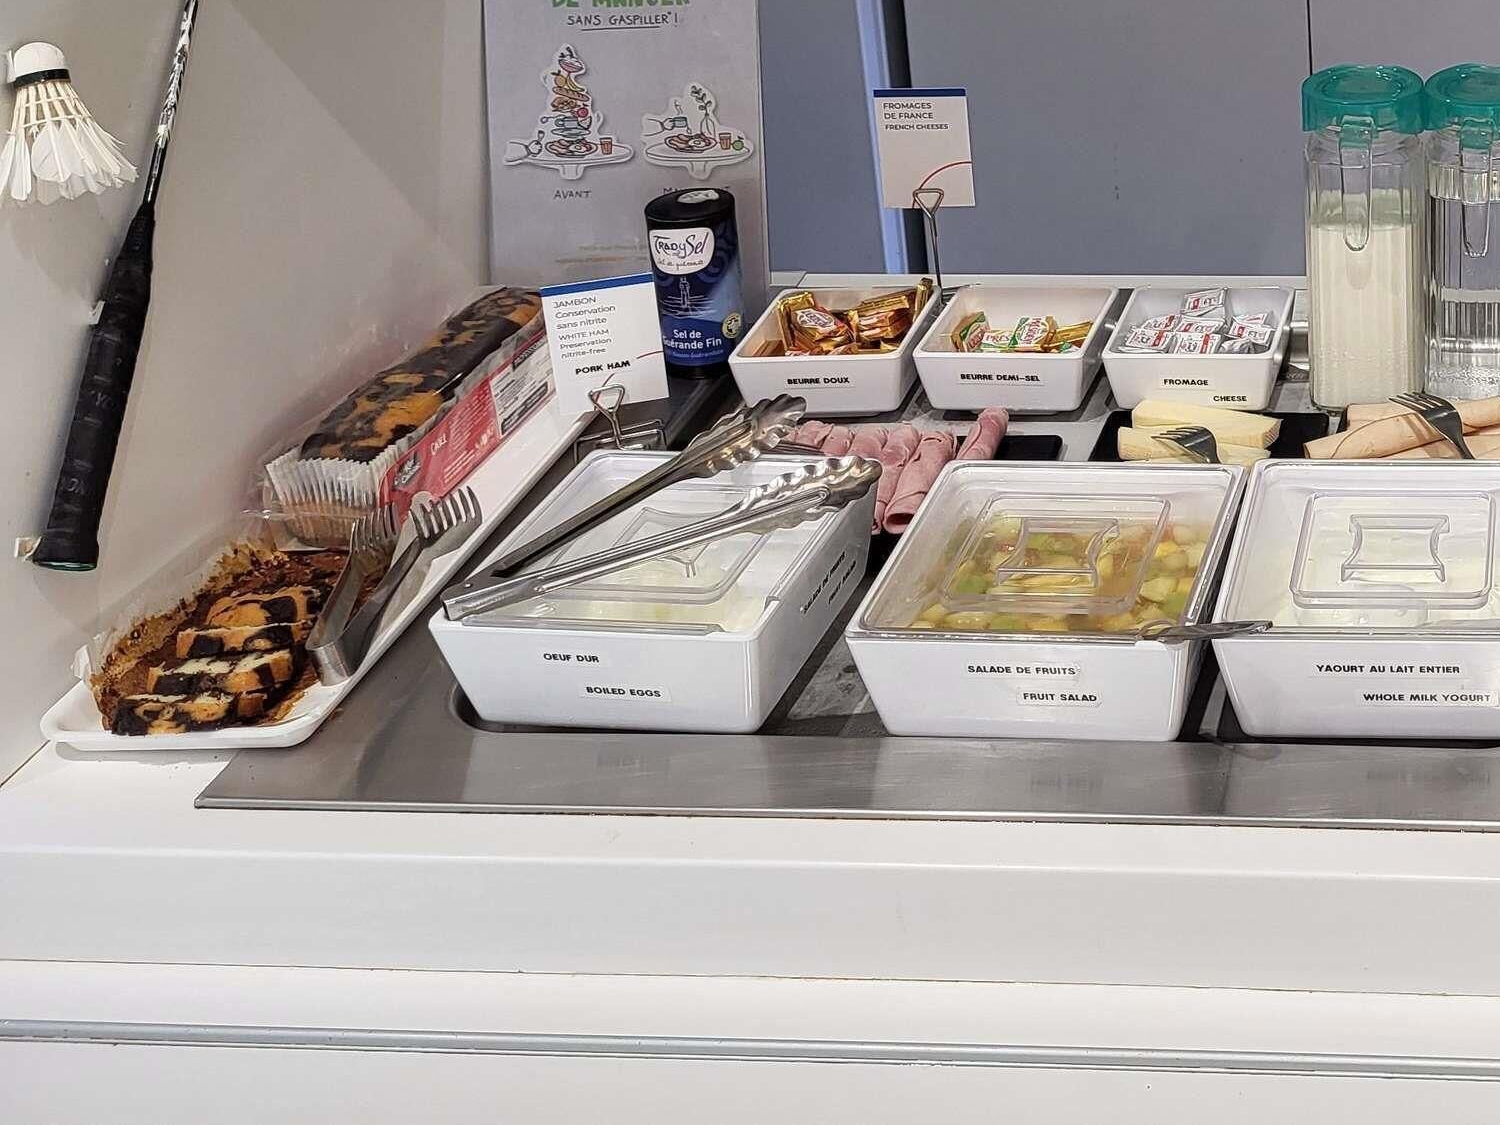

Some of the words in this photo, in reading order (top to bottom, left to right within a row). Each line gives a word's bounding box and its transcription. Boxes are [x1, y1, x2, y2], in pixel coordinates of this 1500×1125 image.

[567, 14, 602, 26] SANS
[883, 102, 932, 110] FROMAGES
[884, 112, 896, 120] DE
[553, 190, 592, 200] AVANT
[553, 296, 597, 309] JAMBON
[555, 305, 616, 319] Conservation
[556, 321, 578, 329] sans
[580, 317, 607, 327] nitrite
[558, 331, 587, 341] WHITE
[588, 329, 610, 337] HAM
[673, 329, 687, 338] Sel
[689, 329, 702, 338] de
[560, 337, 612, 350] Preservation
[706, 337, 722, 348] Fin
[575, 365, 603, 375] PORK
[607, 360, 631, 370] HAM
[787, 377, 820, 385] BEURRE
[960, 373, 994, 381] BEURRE
[996, 374, 1041, 382] DEMI-SEL
[1163, 378, 1209, 386] FROMAGE
[543, 653, 572, 661] OEUF
[576, 654, 600, 663] DUR
[967, 665, 1012, 674] SALADE
[1016, 666, 1031, 674] DE
[1035, 667, 1076, 675] FRUITS
[1316, 664, 1365, 673] YAOURT
[1369, 665, 1386, 673] AU
[1390, 665, 1414, 673] LAIT
[1419, 666, 1460, 674] ENTIER
[586, 686, 625, 695] BOILED
[629, 688, 662, 697] EGGS
[1023, 693, 1056, 701] FRUIT
[1060, 693, 1097, 702] SALAD
[1363, 693, 1405, 702] WHOLE
[1409, 694, 1438, 702] MILK
[1442, 694, 1491, 702] YOGURT
